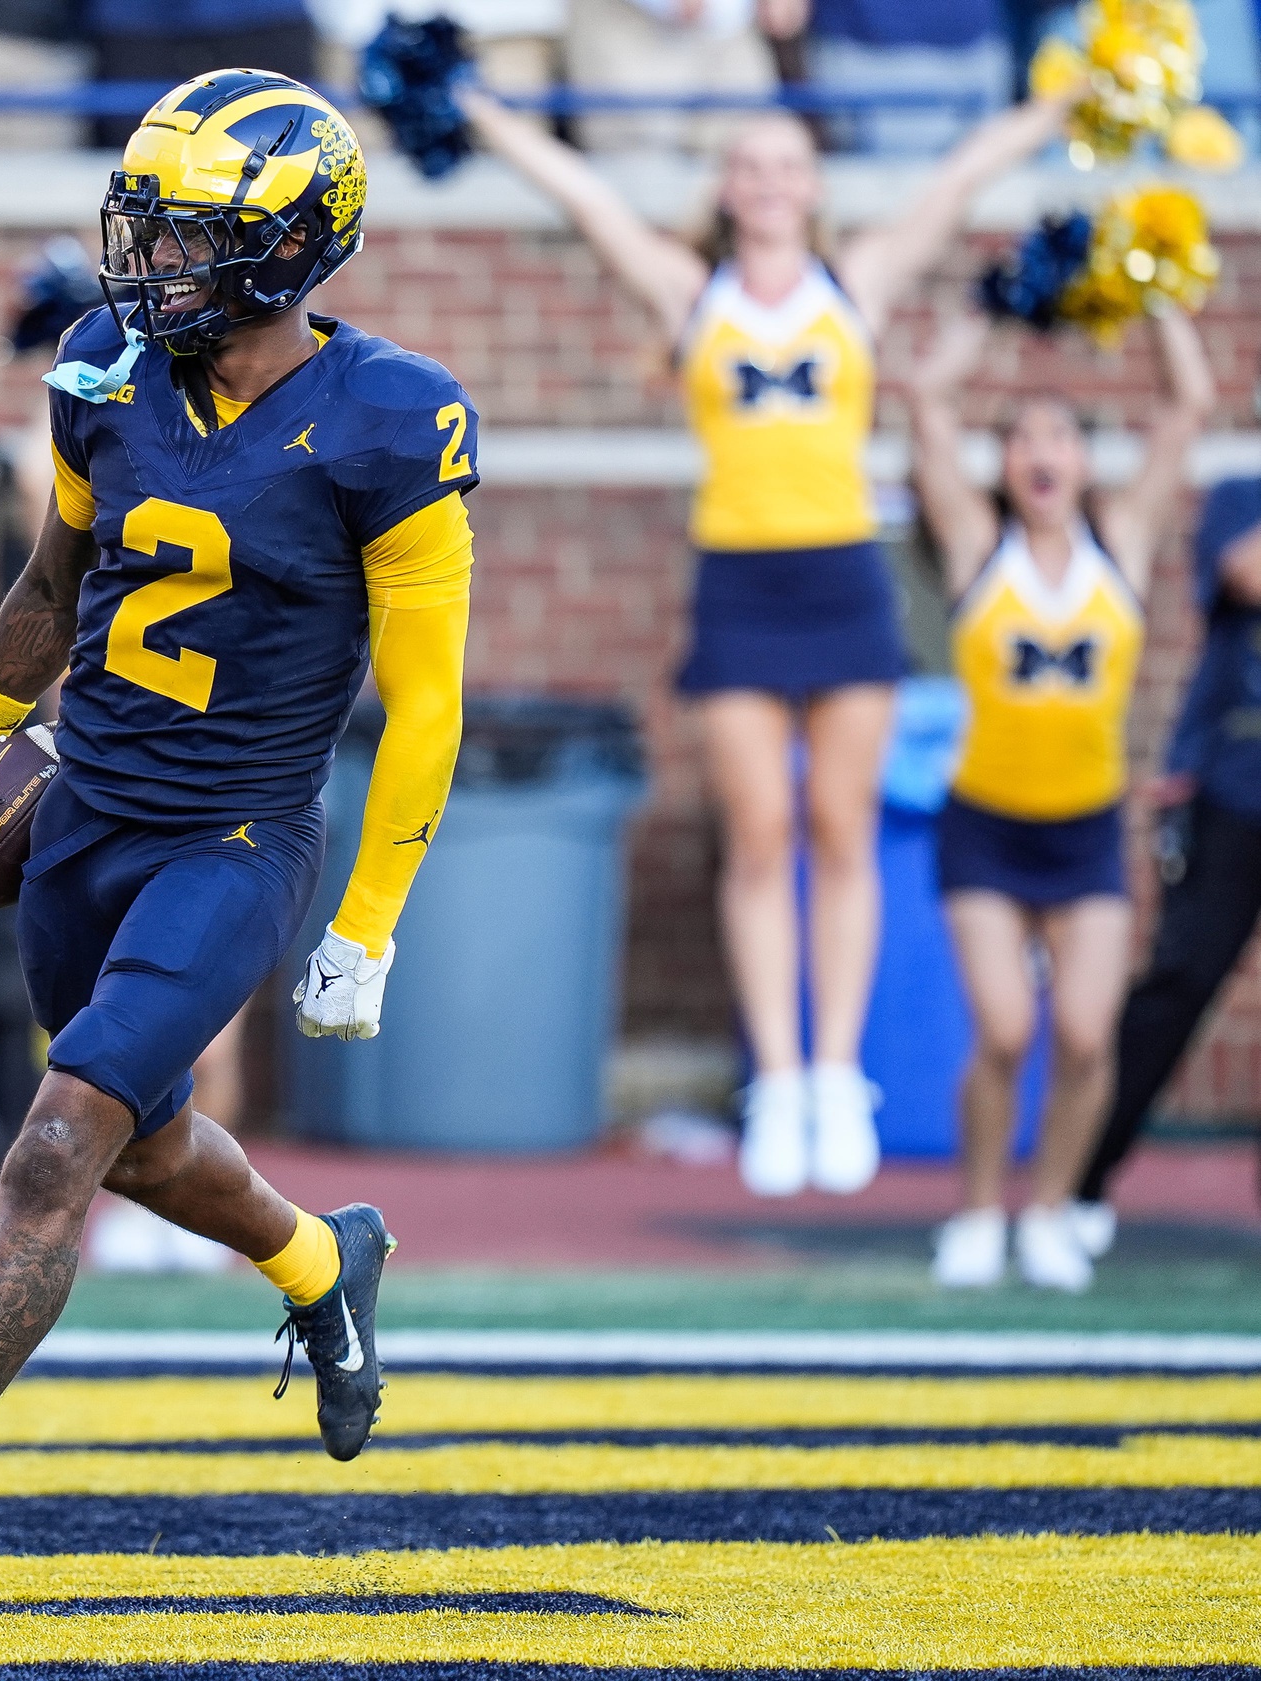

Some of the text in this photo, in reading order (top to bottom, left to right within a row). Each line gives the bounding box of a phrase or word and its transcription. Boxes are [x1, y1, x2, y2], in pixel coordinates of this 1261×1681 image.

[125, 177, 137, 190] M
[737, 361, 817, 402] M
[436, 401, 472, 482] 2
[104, 497, 233, 713] 2
[1014, 640, 1090, 682] M
[12, 775, 41, 809] ELITE
